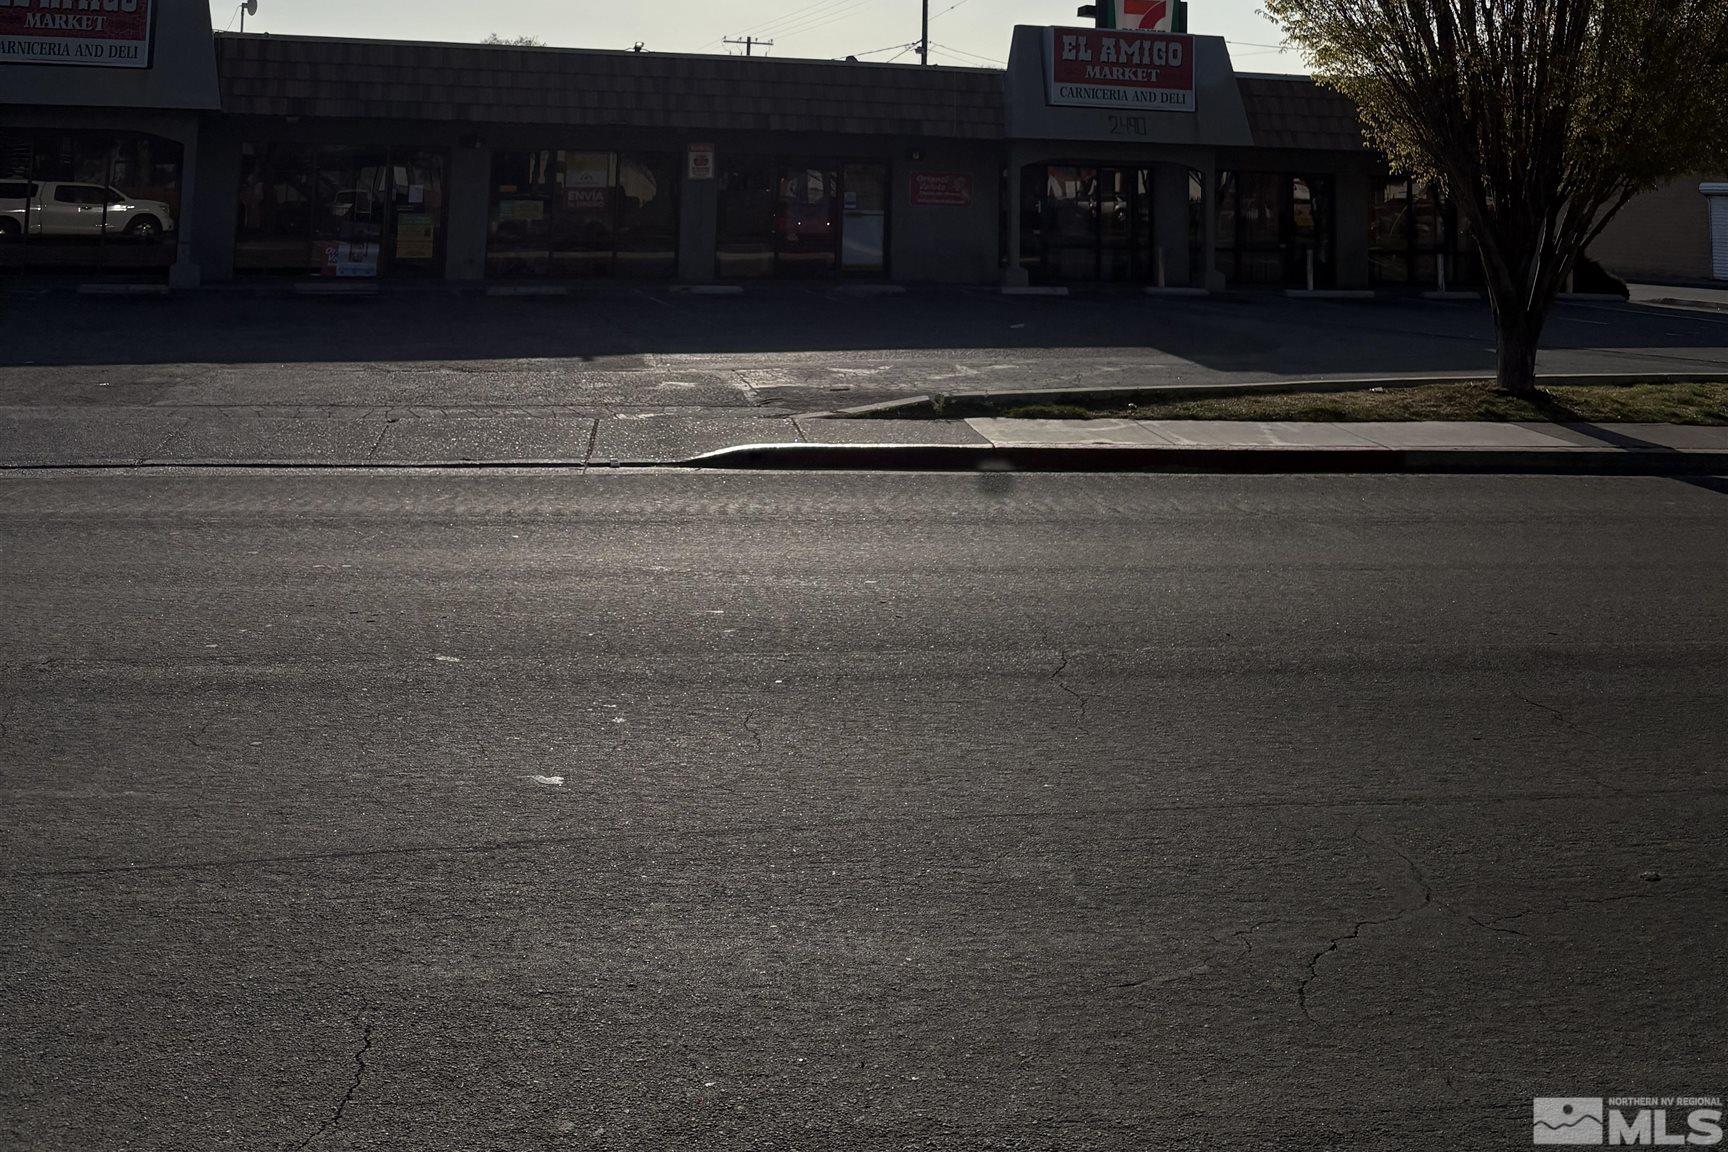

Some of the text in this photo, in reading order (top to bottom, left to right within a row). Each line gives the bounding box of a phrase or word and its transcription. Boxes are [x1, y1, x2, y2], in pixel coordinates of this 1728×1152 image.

[24, 12, 107, 31] MARKET
[0, 40, 139, 59] ARNICERIA AND DELI
[1062, 35, 1183, 67] EL AMIGO
[1085, 64, 1160, 82] MARKET
[1059, 86, 1186, 105] CARNICERIA AND DELI
